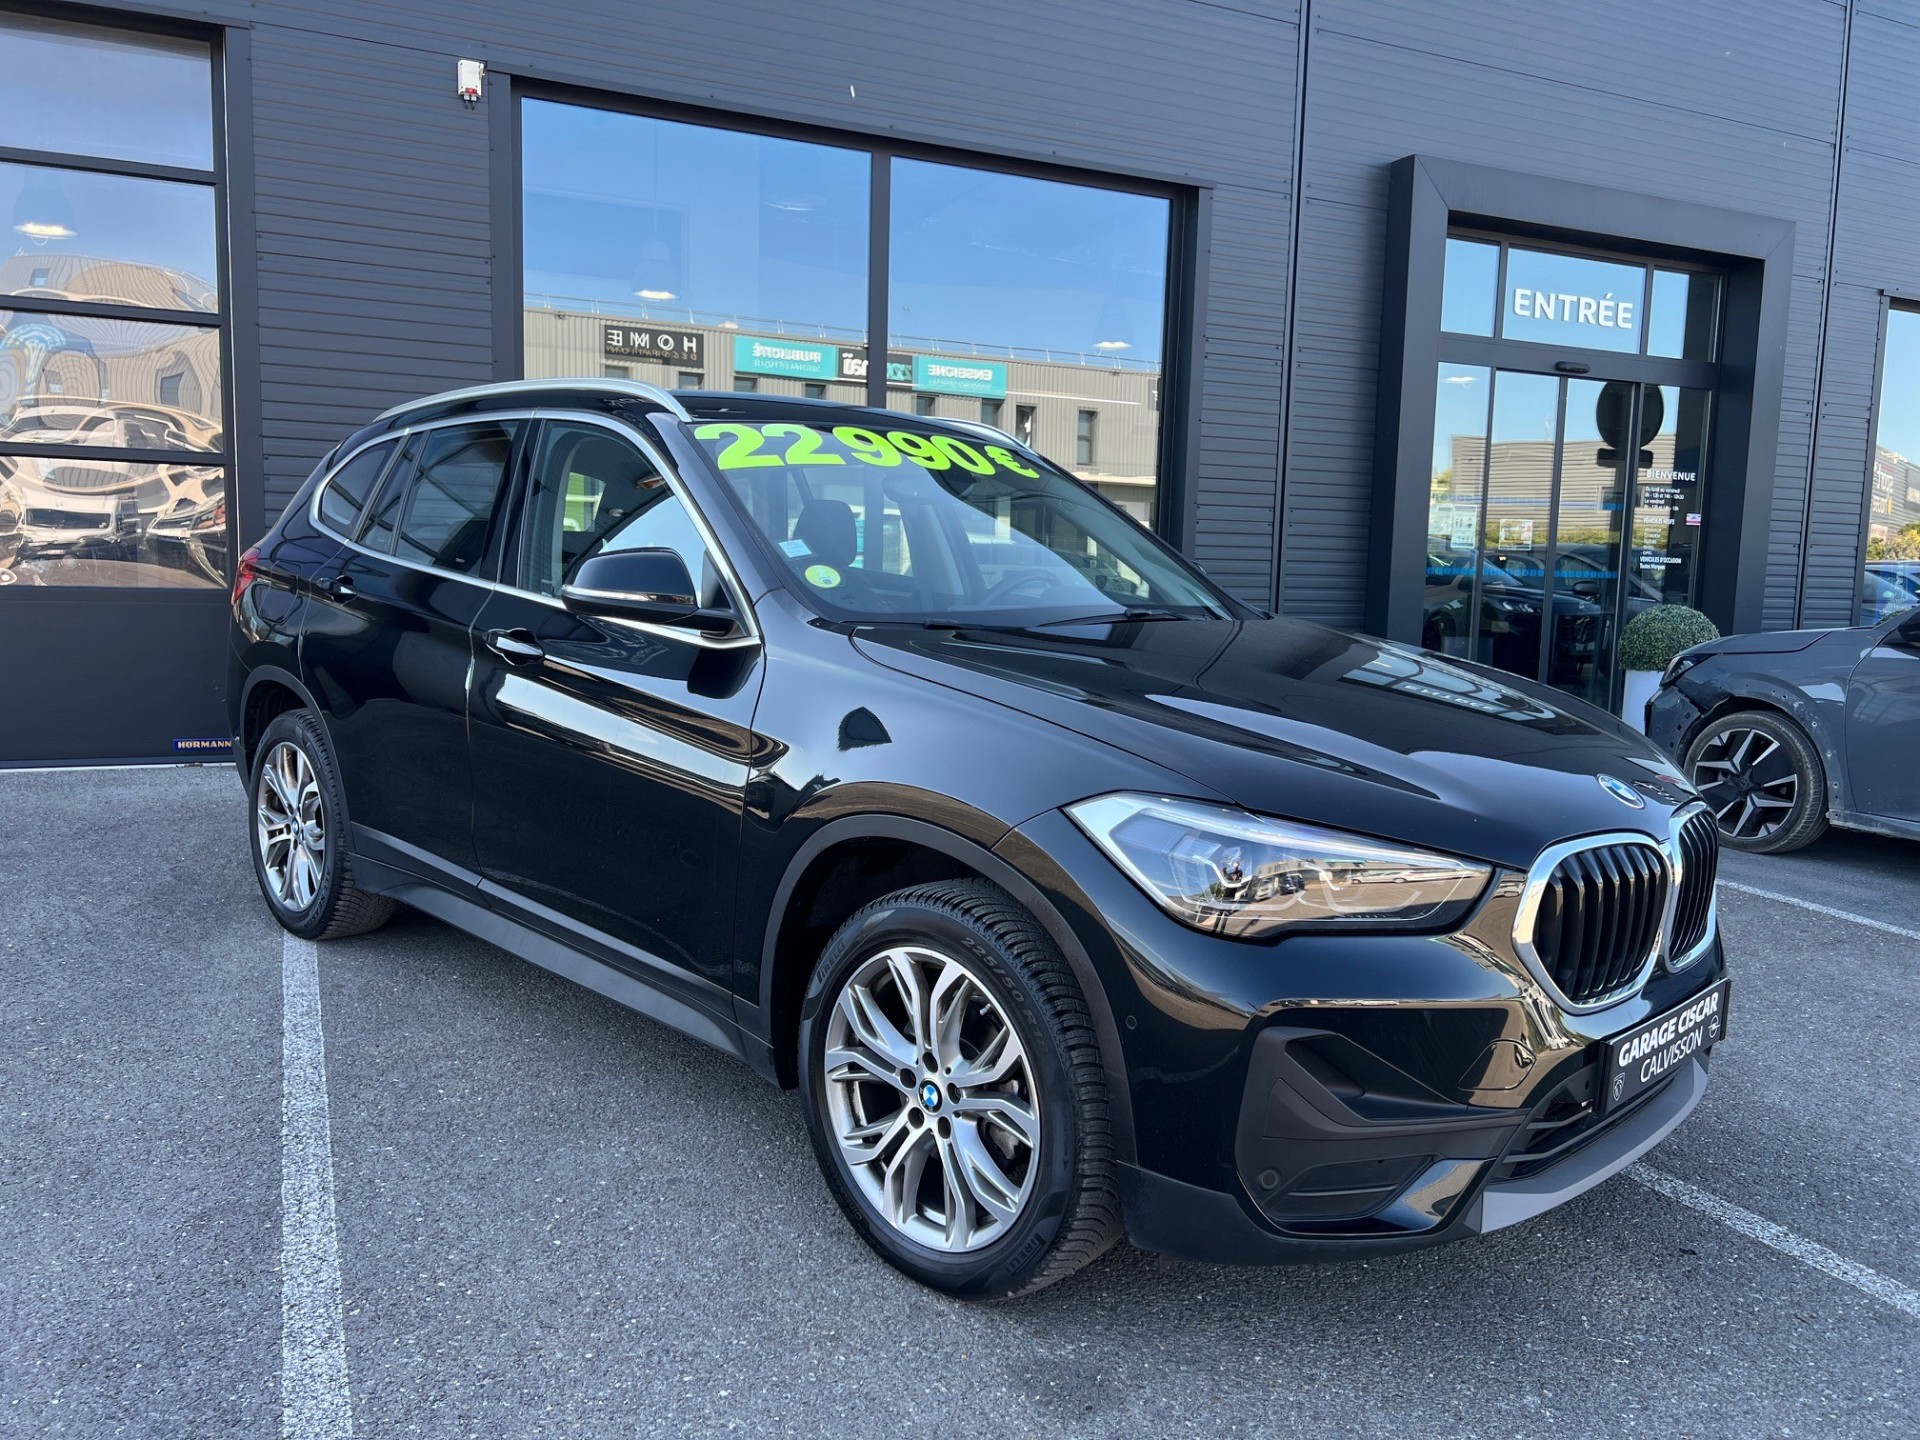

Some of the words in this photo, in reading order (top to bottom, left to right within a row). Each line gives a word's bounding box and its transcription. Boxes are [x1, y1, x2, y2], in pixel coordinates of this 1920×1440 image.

[1514, 288, 1634, 329] ENTRÉE
[1646, 469, 1696, 481] BIENVENUE
[960, 937, 1025, 1002] 225/50
[1618, 1016, 1678, 1067] GARAGE
[1677, 991, 1719, 1034] CISCAR
[1640, 1026, 1704, 1083] CALVISSON
